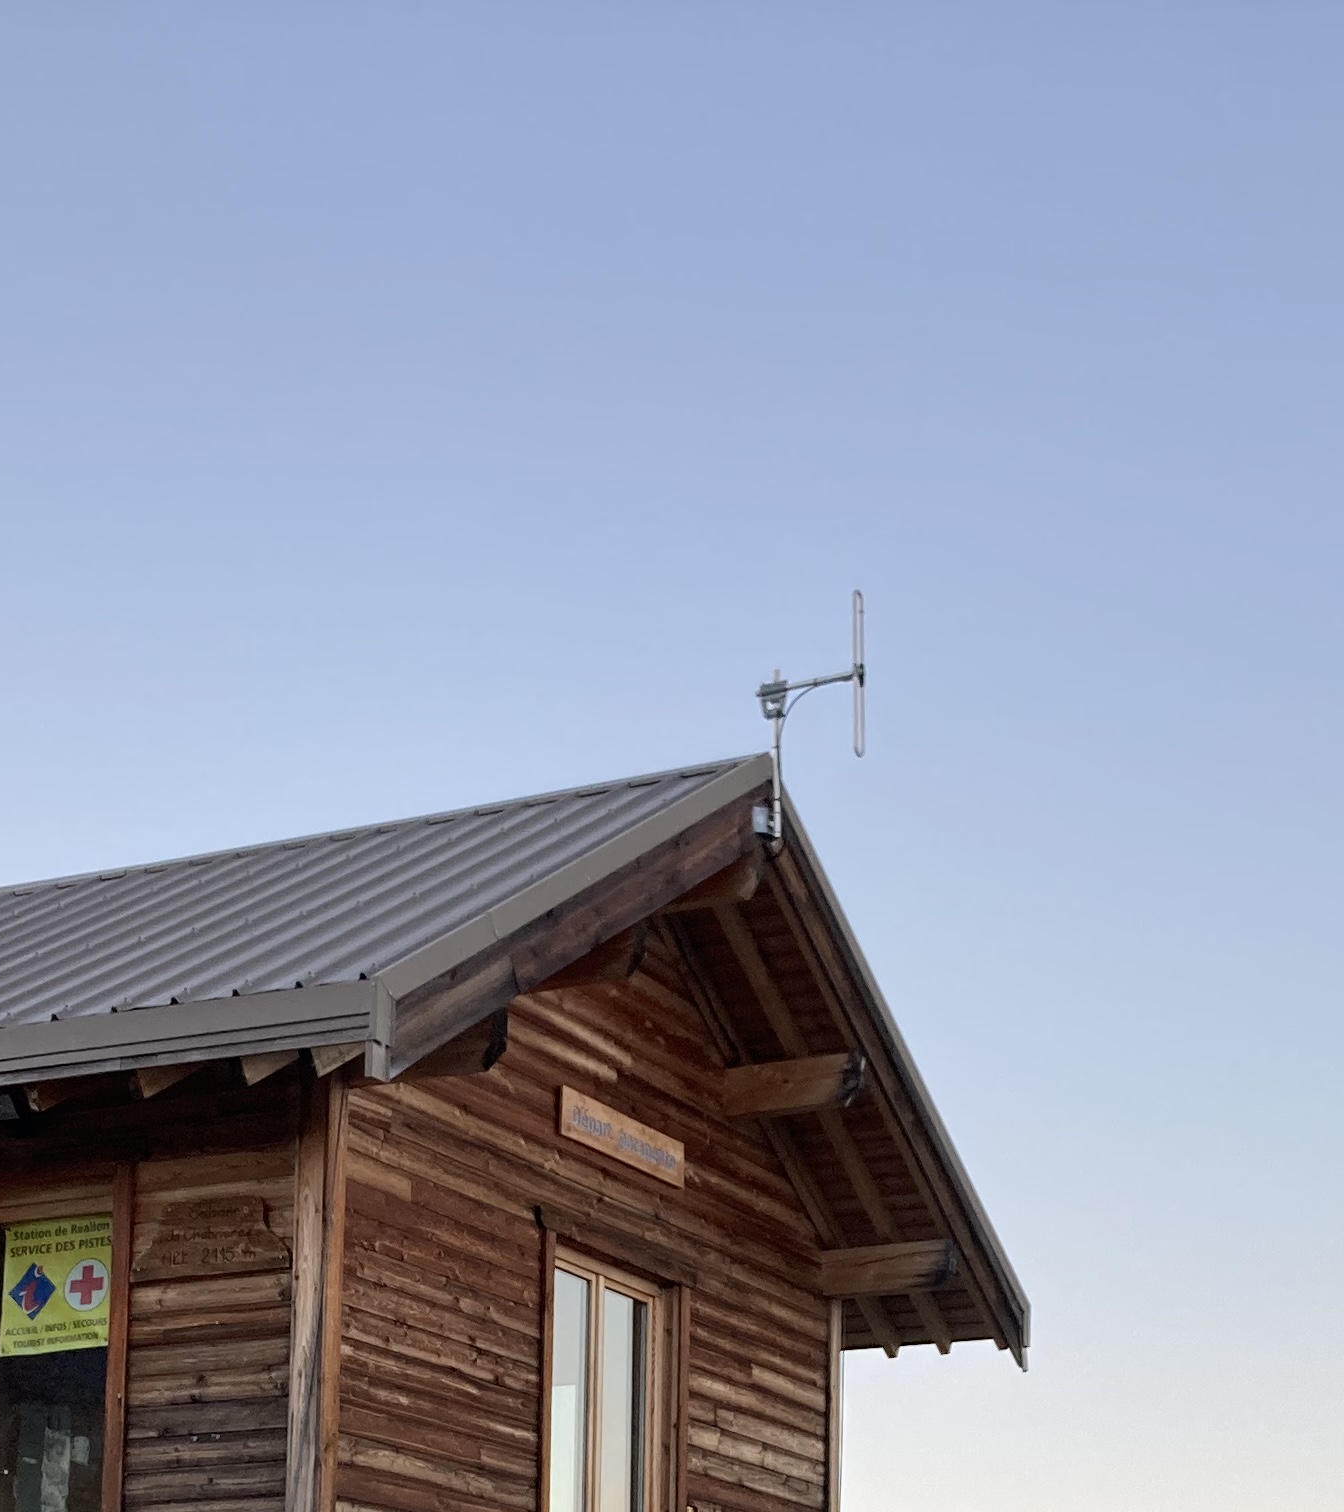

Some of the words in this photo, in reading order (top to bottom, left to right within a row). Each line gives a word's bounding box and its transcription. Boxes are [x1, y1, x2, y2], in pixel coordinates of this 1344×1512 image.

[12, 1229, 52, 1241] Station
[54, 1224, 68, 1237] de
[10, 1243, 52, 1257] SERVICE
[55, 1239, 76, 1252] DES
[78, 1236, 112, 1249] PISTES
[72, 1318, 107, 1329] SECOURS
